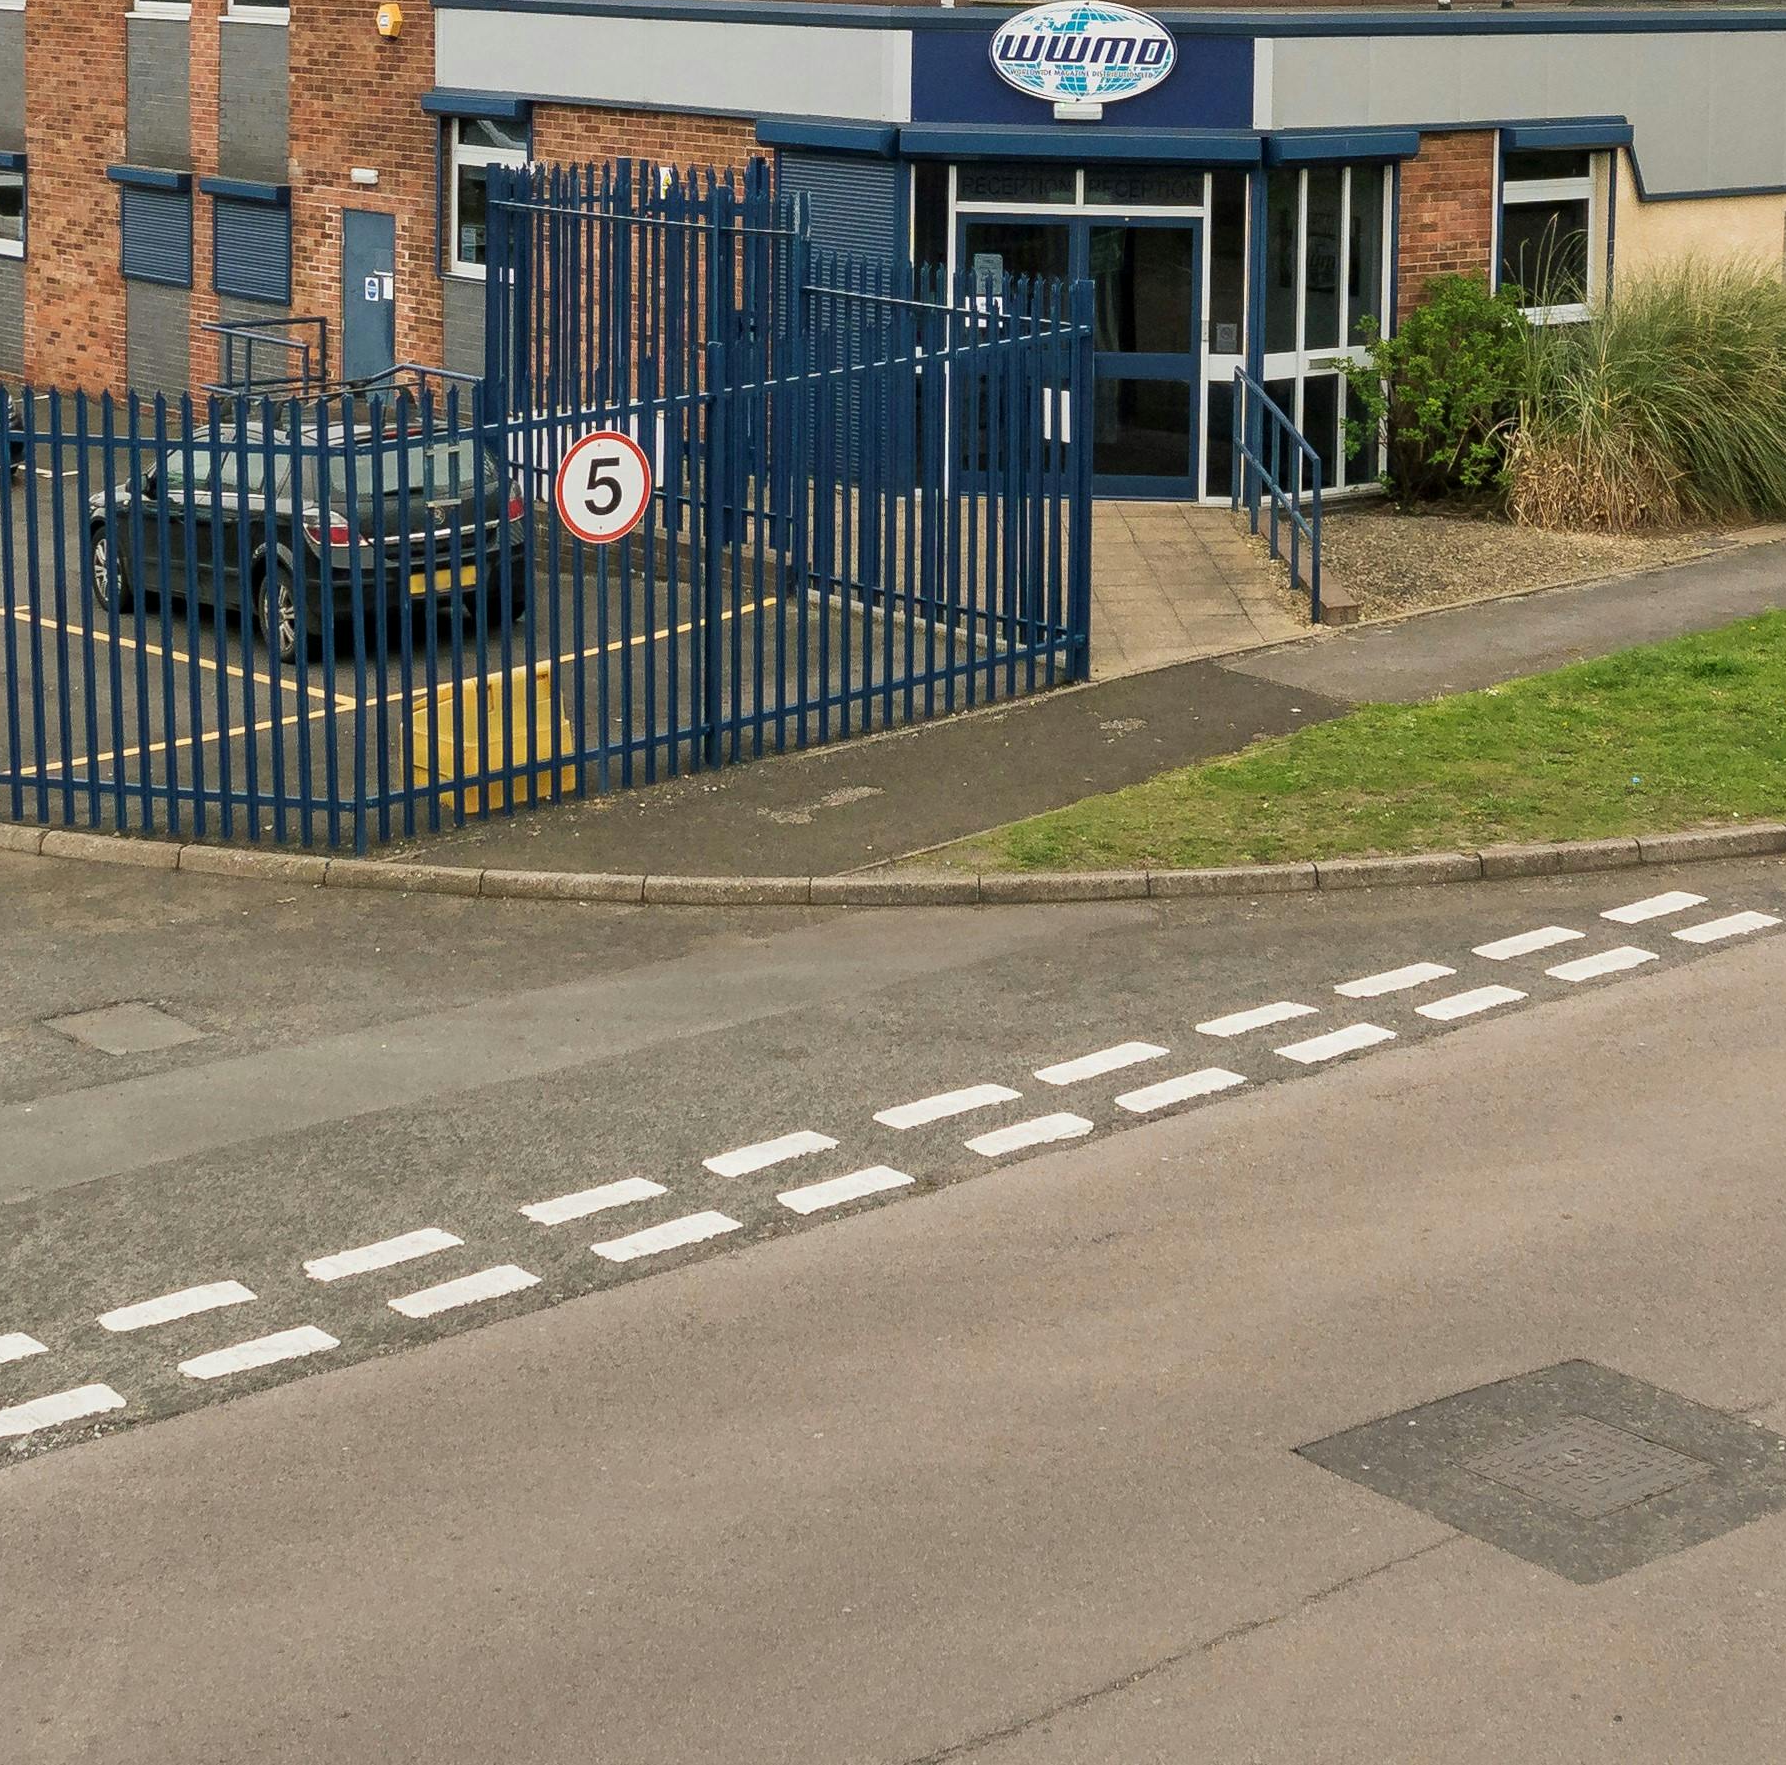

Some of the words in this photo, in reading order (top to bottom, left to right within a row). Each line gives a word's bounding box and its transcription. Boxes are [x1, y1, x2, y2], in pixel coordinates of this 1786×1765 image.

[1010, 68, 1052, 77] WORLDWIDE
[1053, 69, 1090, 77] MAGAZINE
[961, 176, 1072, 195] RECEPTION
[584, 456, 623, 516] 5
